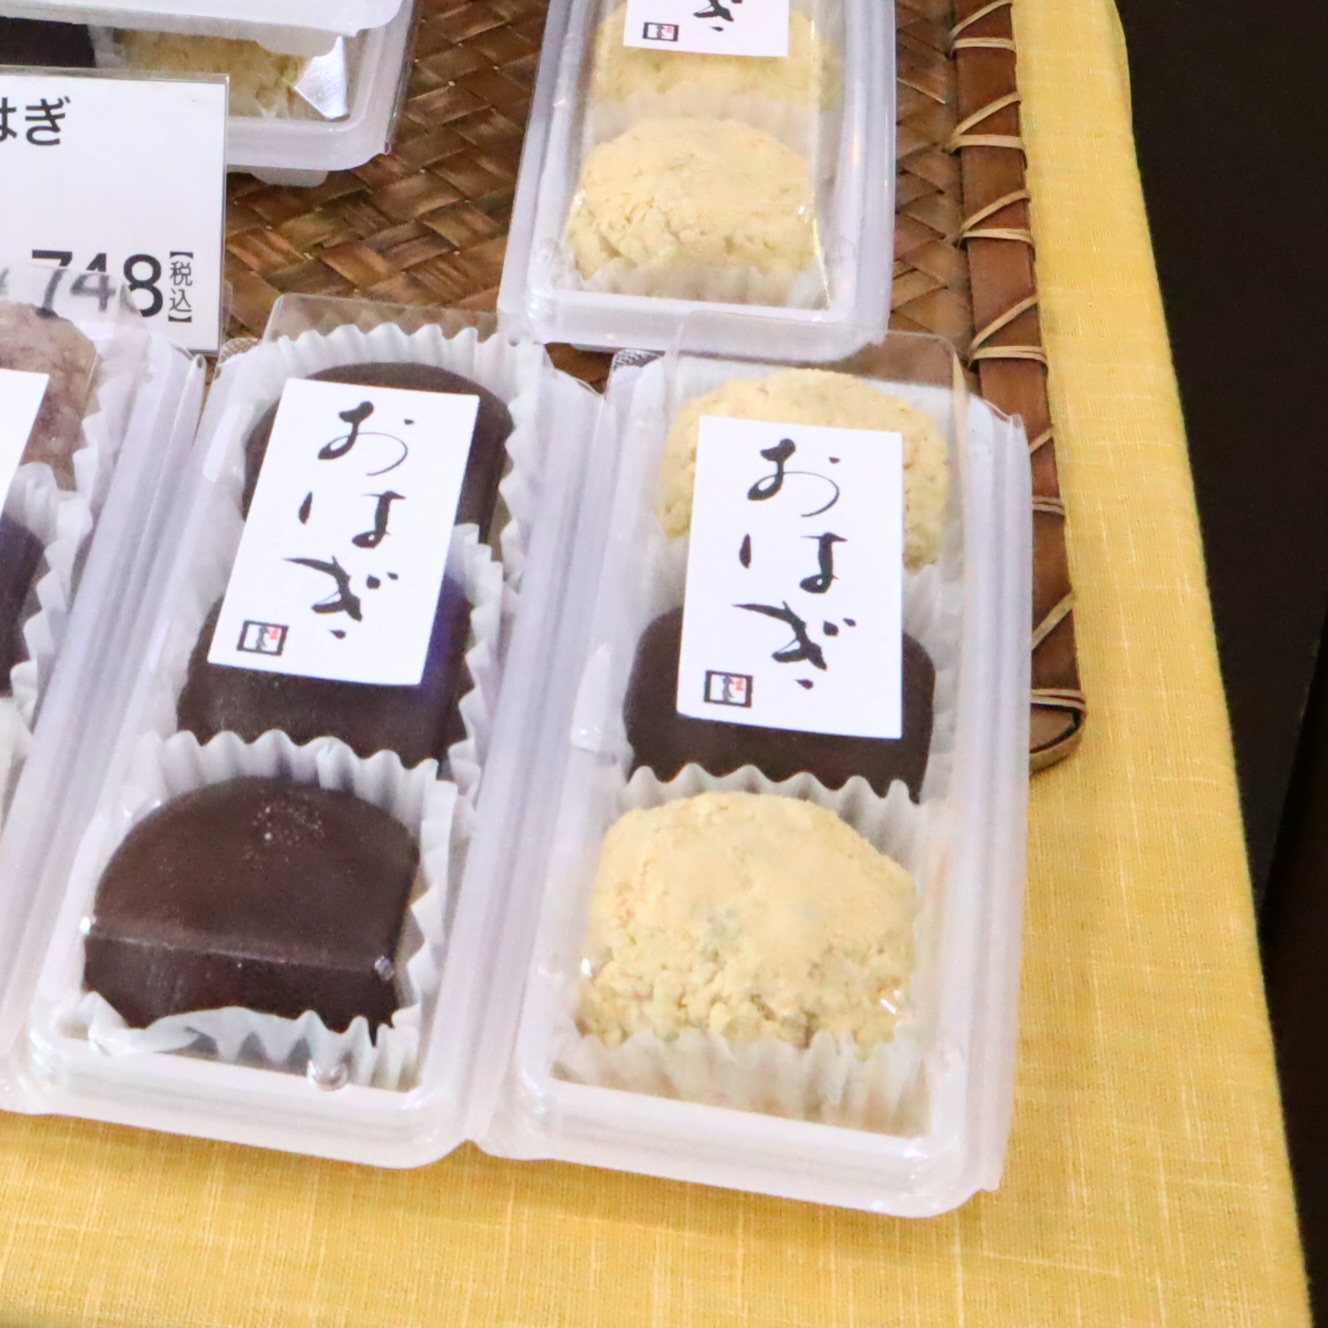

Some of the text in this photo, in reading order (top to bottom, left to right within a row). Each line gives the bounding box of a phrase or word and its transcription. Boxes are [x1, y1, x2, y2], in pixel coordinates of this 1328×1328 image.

[31, 249, 163, 320] 748
[282, 400, 415, 640] おはぎ
[731, 437, 857, 690] おはぎ
